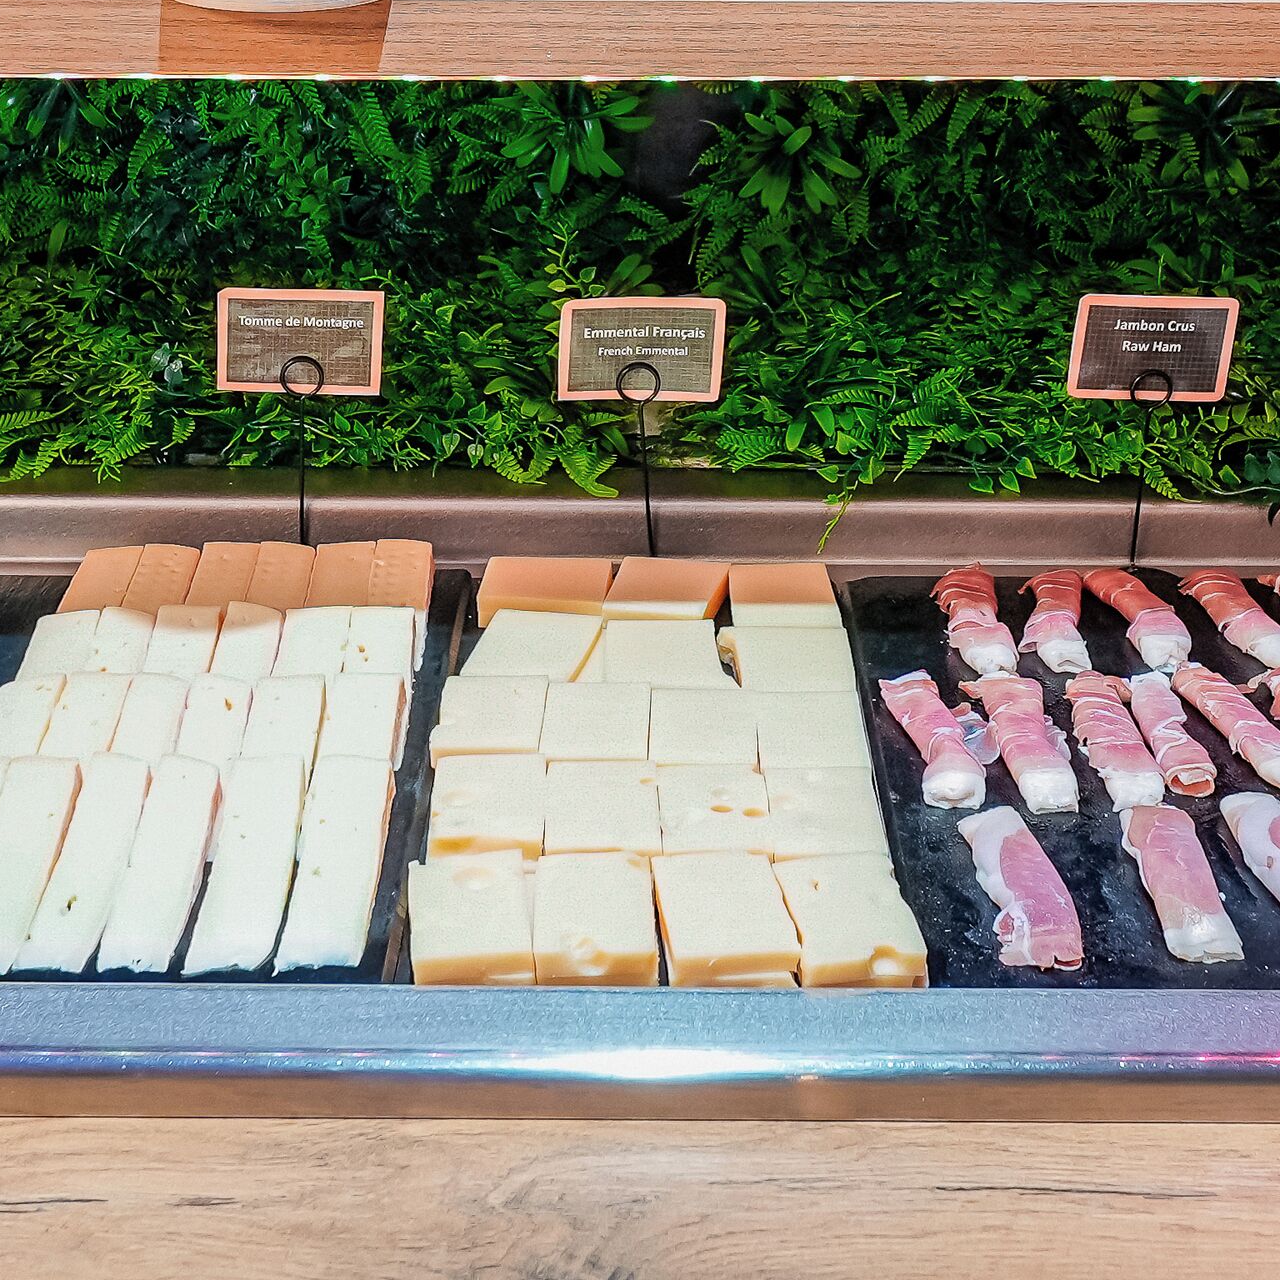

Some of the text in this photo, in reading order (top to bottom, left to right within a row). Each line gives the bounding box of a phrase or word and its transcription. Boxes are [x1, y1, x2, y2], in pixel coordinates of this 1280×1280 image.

[237, 315, 365, 331] Tomme de Montagne
[1113, 318, 1196, 333] Jambon Crus
[583, 326, 706, 341] Emmental Français
[597, 345, 689, 357] French Emmental
[1121, 340, 1182, 353] Raw Ham
